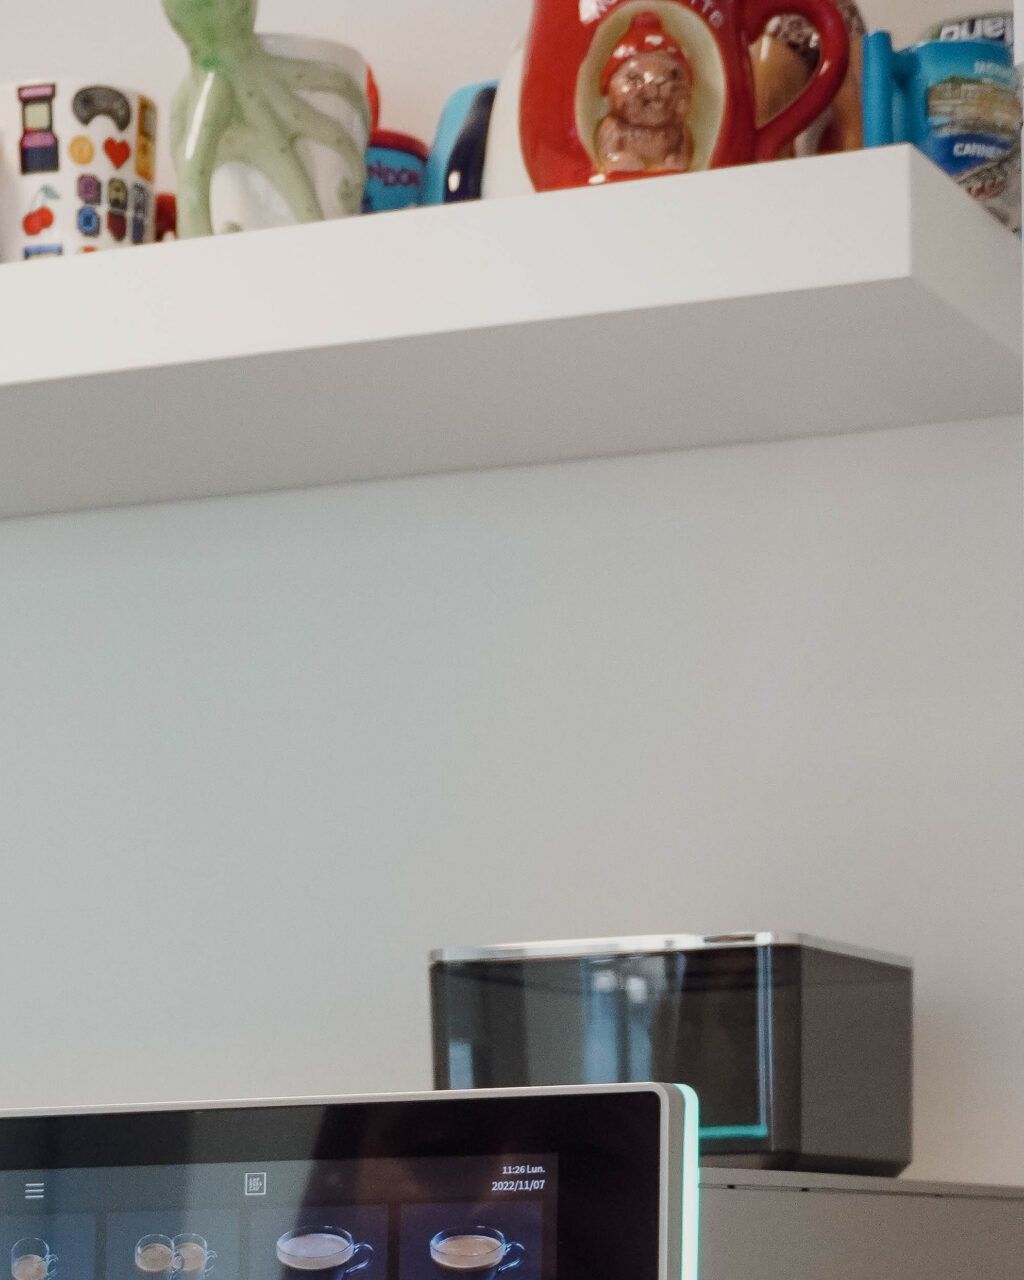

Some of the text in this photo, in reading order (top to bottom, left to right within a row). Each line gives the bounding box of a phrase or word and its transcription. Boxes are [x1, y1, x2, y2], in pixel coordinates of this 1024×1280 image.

[502, 1164, 546, 1174] 11:26 Lun.
[491, 1179, 546, 1191] 2022/11/07
